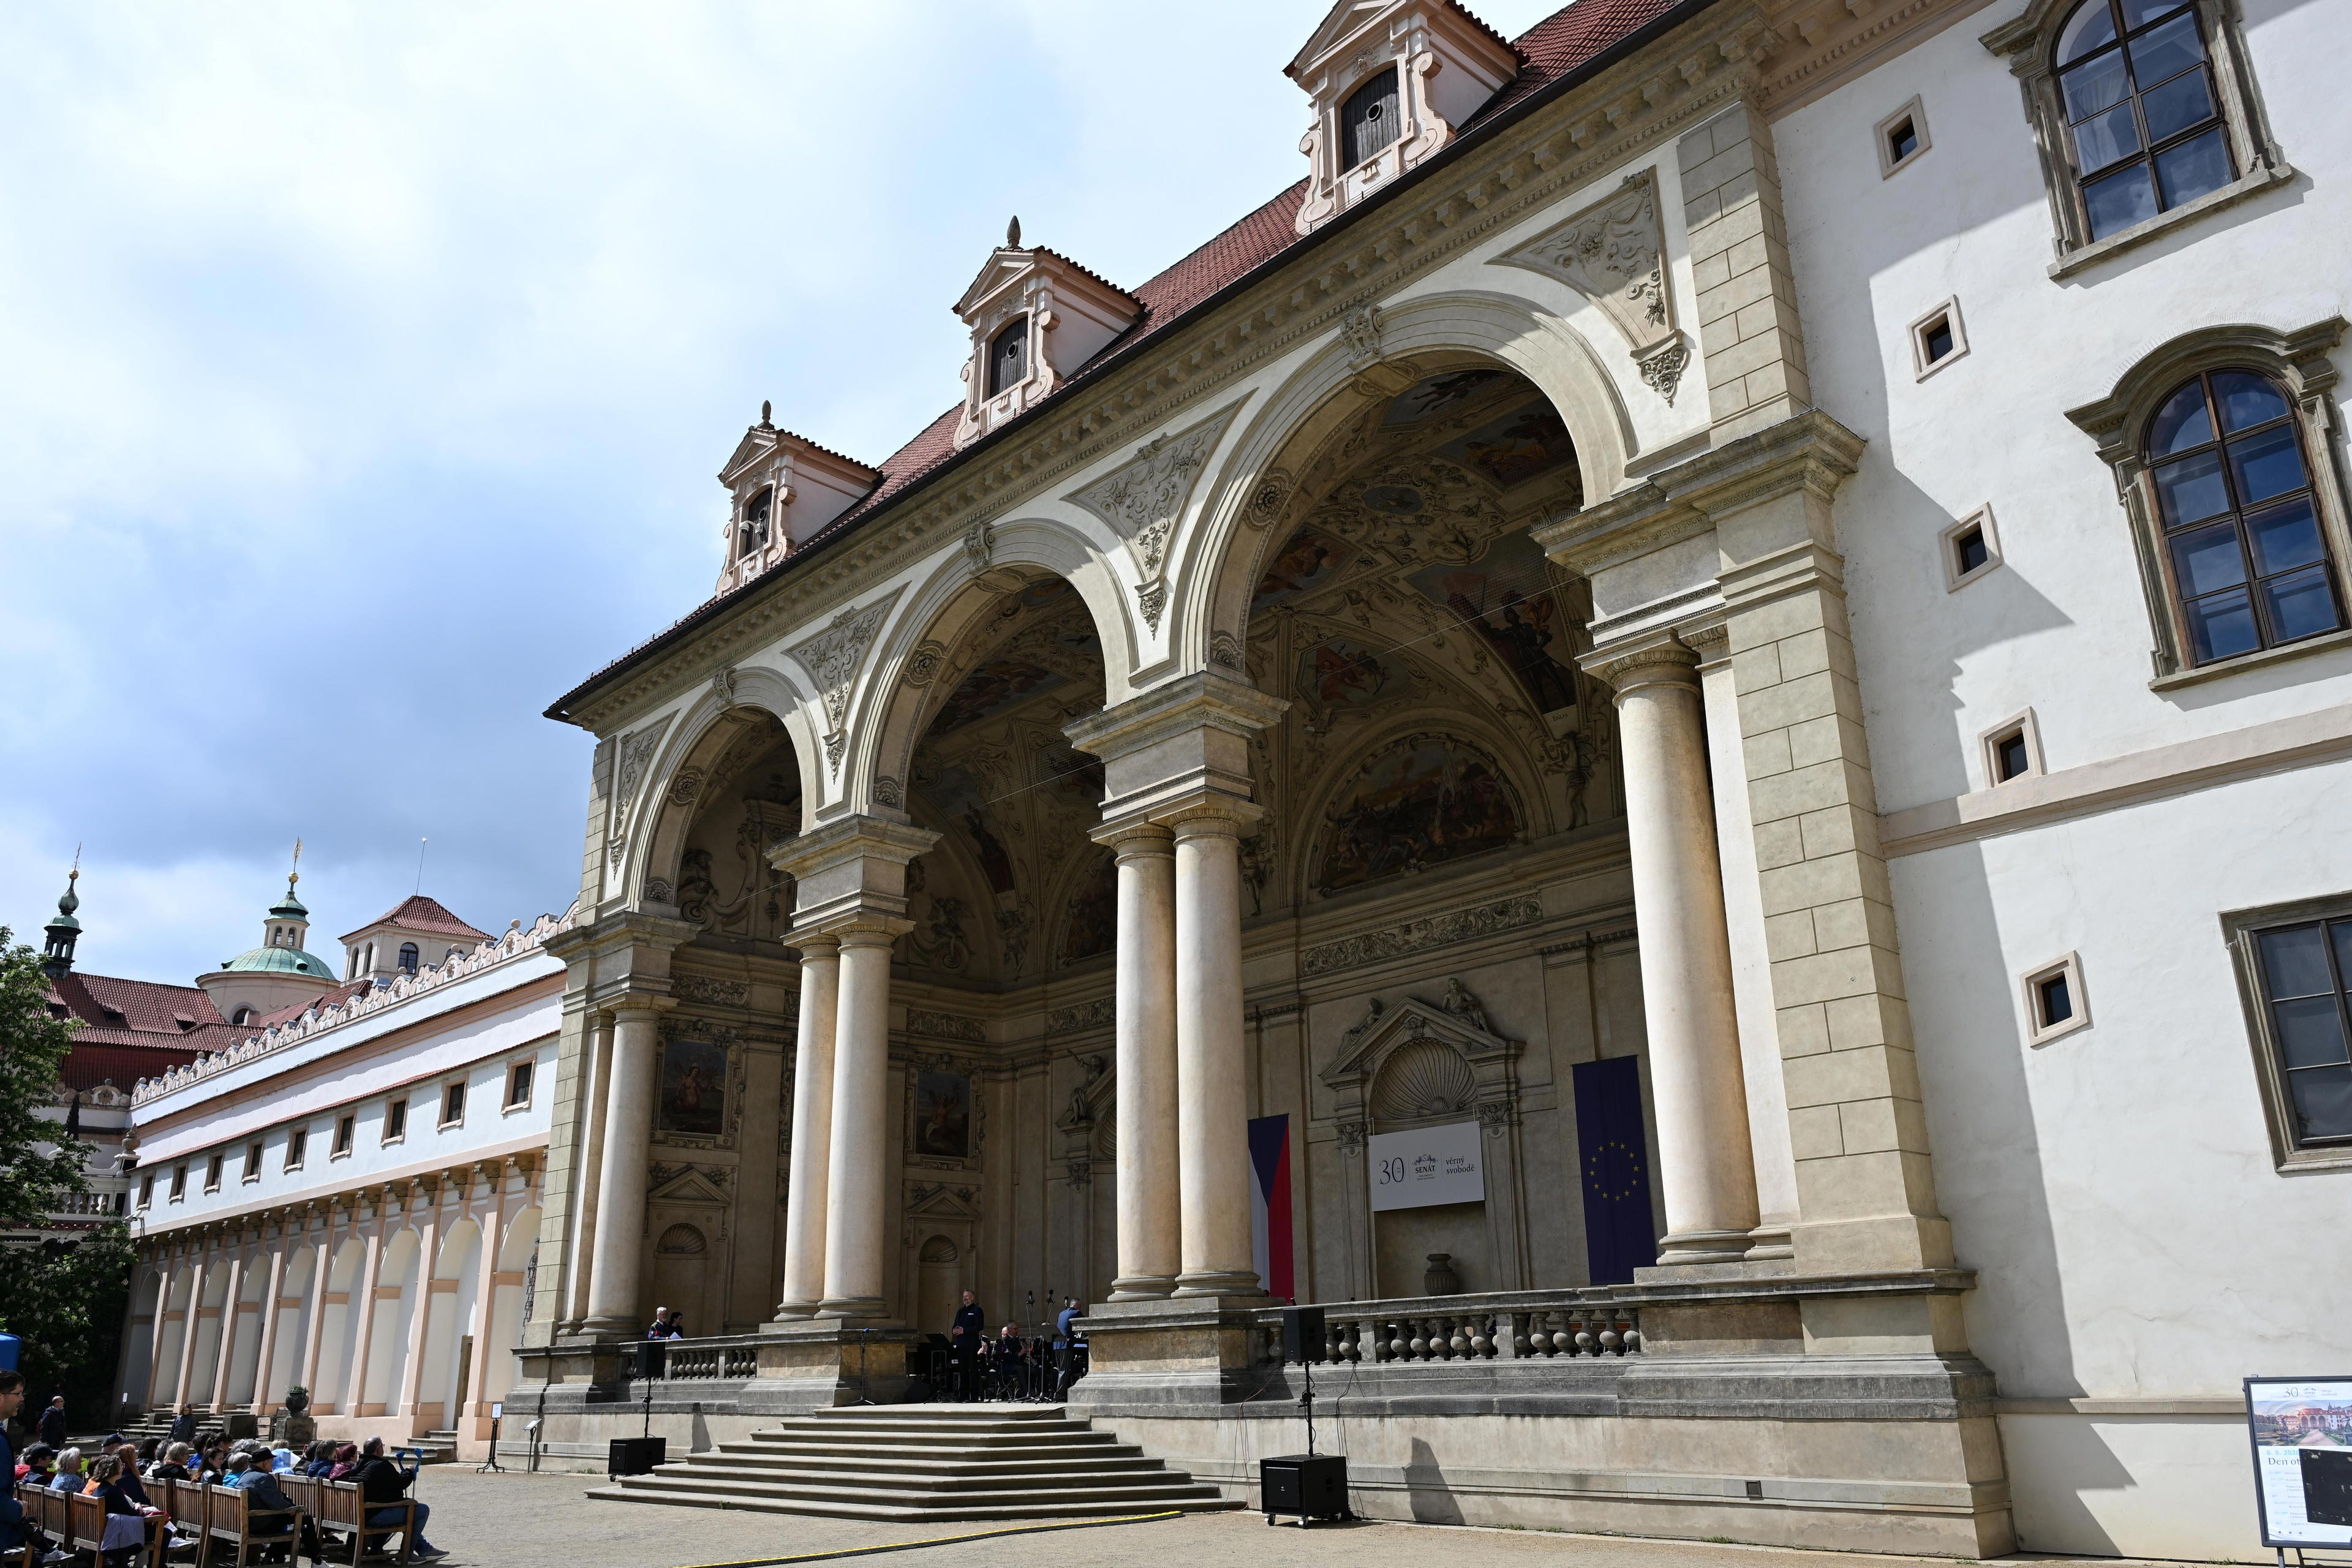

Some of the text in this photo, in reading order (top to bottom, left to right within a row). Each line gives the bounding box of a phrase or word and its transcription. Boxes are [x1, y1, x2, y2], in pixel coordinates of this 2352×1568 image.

[1446, 1155, 1465, 1166] věrný
[1379, 1157, 1404, 1185] 30
[1415, 1164, 1436, 1174] SENÁT
[1446, 1164, 1475, 1175] svobodě
[2283, 1387, 2299, 1398] 30
